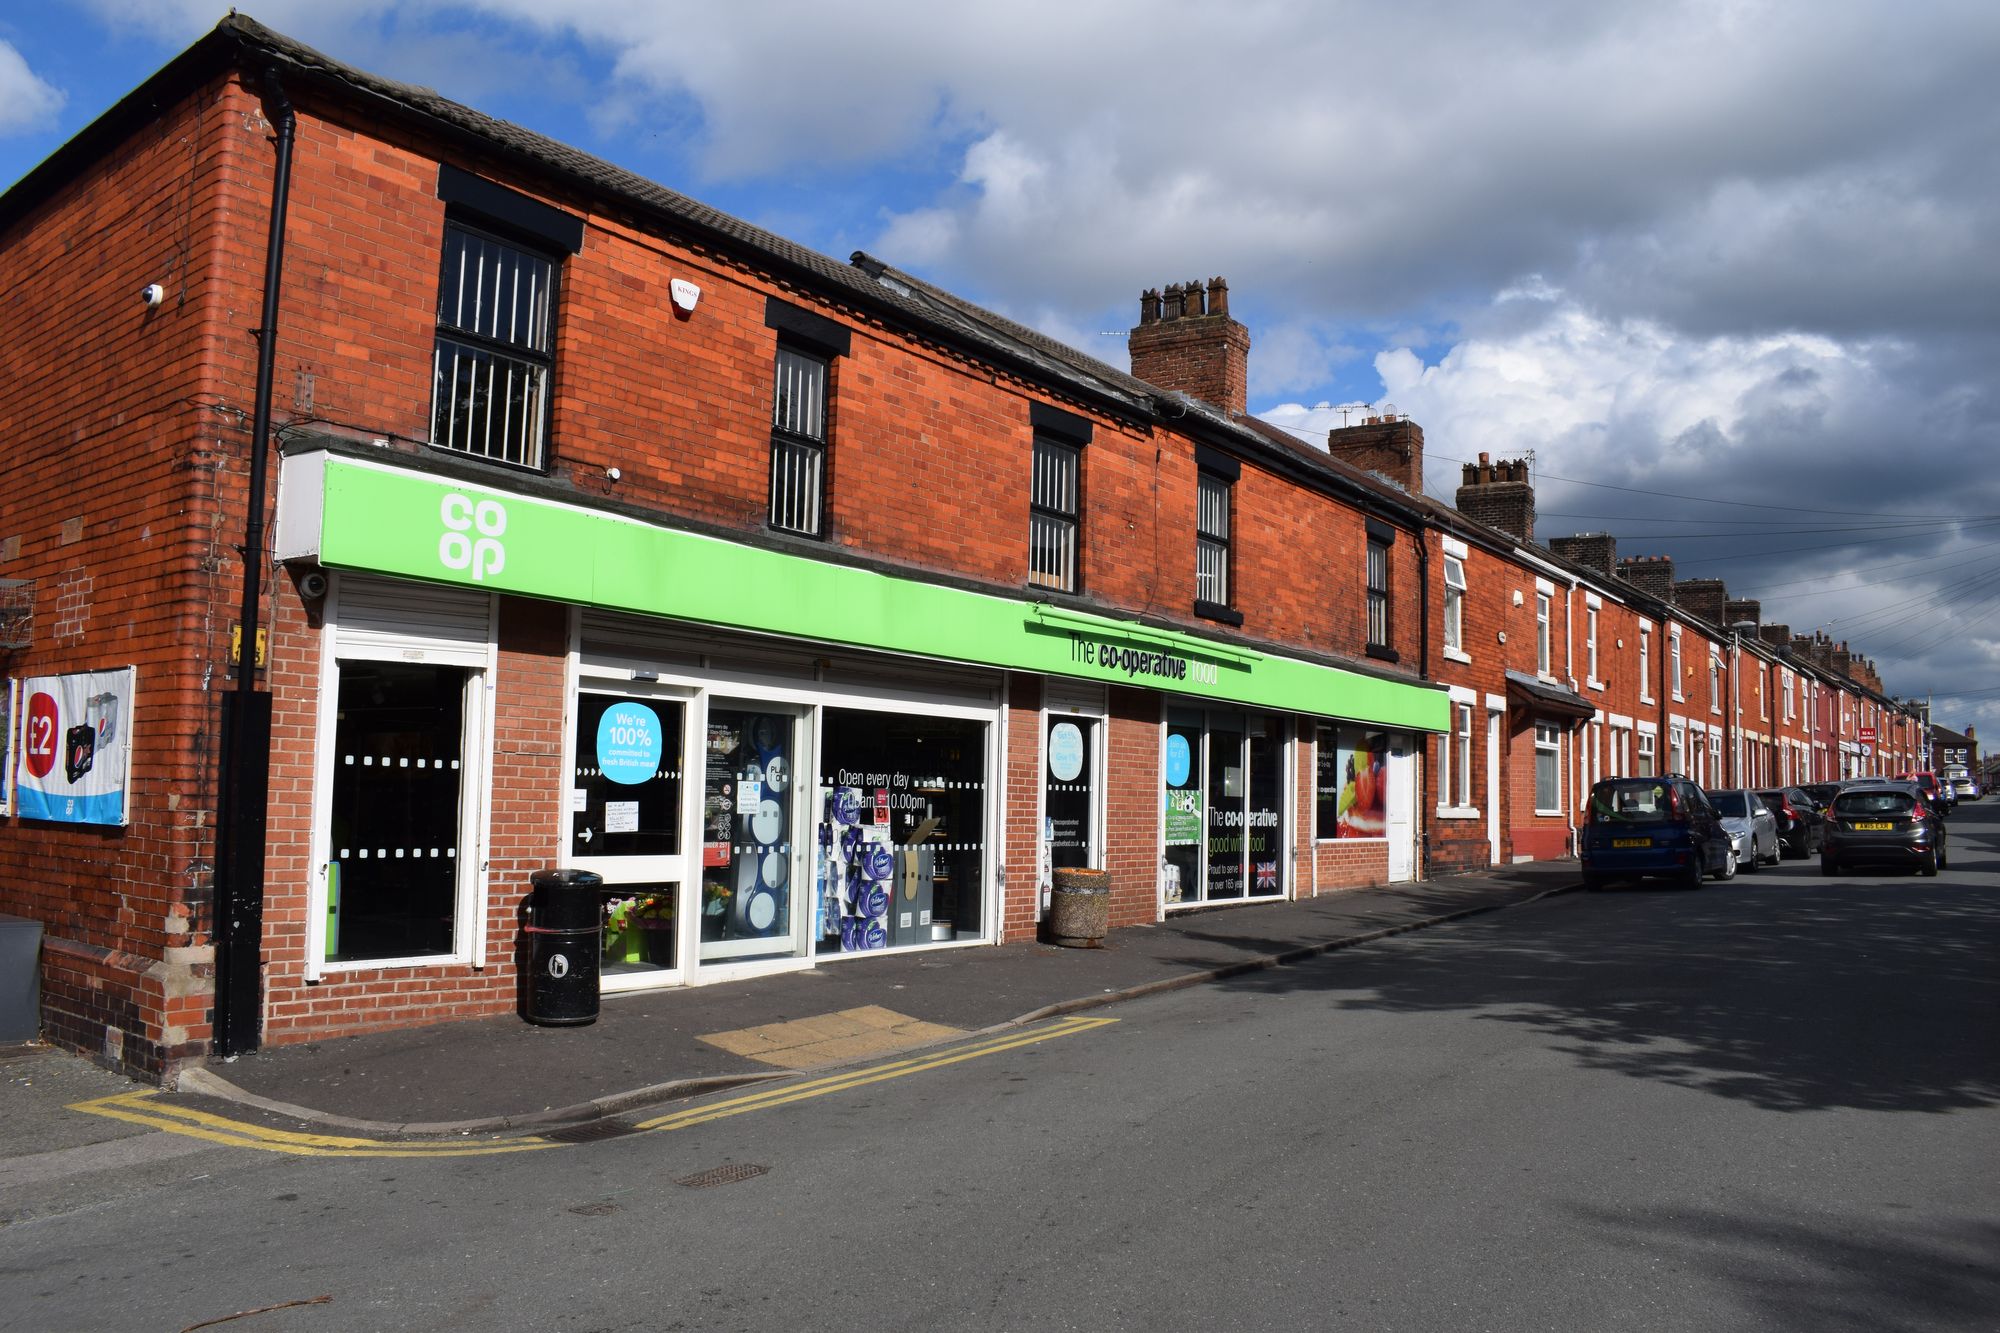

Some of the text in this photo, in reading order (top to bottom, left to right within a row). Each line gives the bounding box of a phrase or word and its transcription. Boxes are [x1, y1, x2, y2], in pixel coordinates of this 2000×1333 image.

[1068, 632, 1218, 685] The co-operative food
[616, 713, 646, 727] We're
[30, 715, 52, 755] £2
[609, 727, 652, 747] 100%
[602, 757, 656, 768] fresh British meat
[608, 749, 650, 758] committed to
[838, 768, 909, 789] Open every day
[838, 792, 875, 809] 700am
[887, 793, 925, 812] 10.00pm
[1208, 806, 1278, 827] The co-oerative
[1208, 833, 1229, 857] good
[1248, 833, 1265, 852] food
[1208, 864, 1221, 875] Proud
[1221, 864, 1226, 874] to
[1226, 865, 1238, 874] serve
[1214, 881, 1225, 890] over
[1225, 879, 1234, 889] 165
